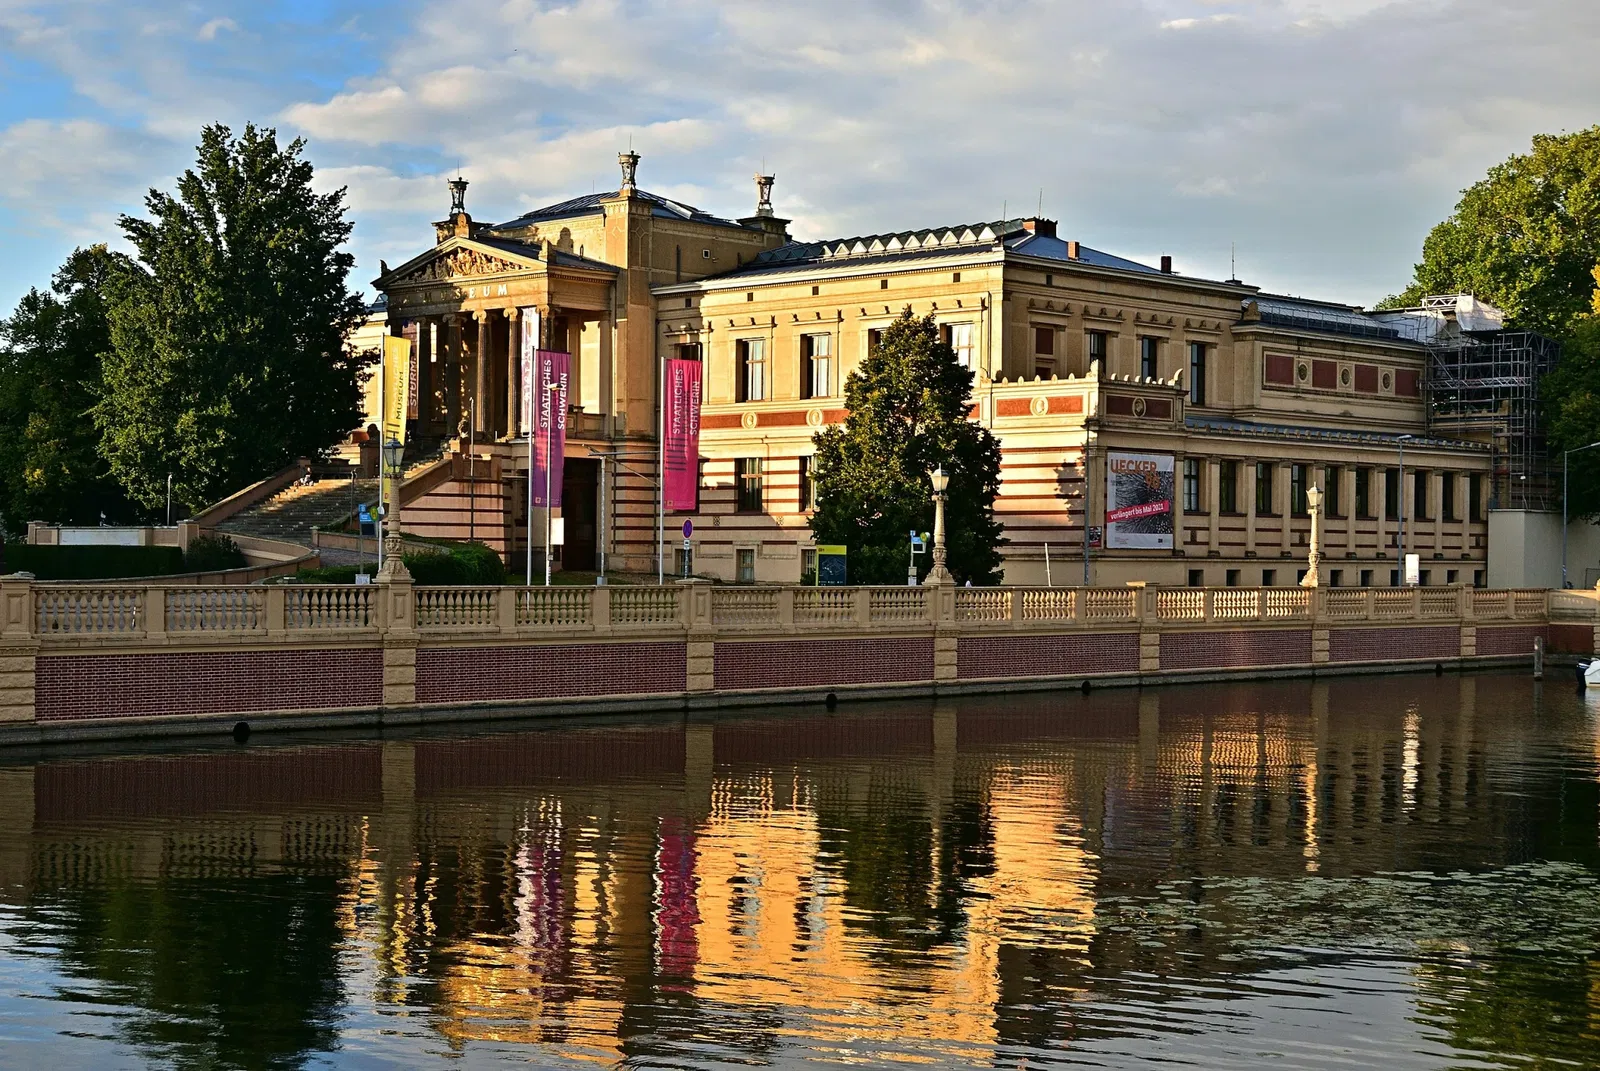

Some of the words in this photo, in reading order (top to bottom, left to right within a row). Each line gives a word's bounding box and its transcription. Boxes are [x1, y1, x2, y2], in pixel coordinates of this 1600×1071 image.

[396, 371, 404, 420] MUSEUM
[409, 357, 417, 407] STURM.
[540, 359, 552, 428] STAATLICHES
[558, 372, 568, 430] SCHWERIN
[672, 368, 683, 435] STAATLICHES
[689, 381, 700, 436] SCHWERIN
[1110, 458, 1157, 474] UECKER
[1110, 508, 1135, 520] verlängert
[1142, 504, 1152, 513] Mai
